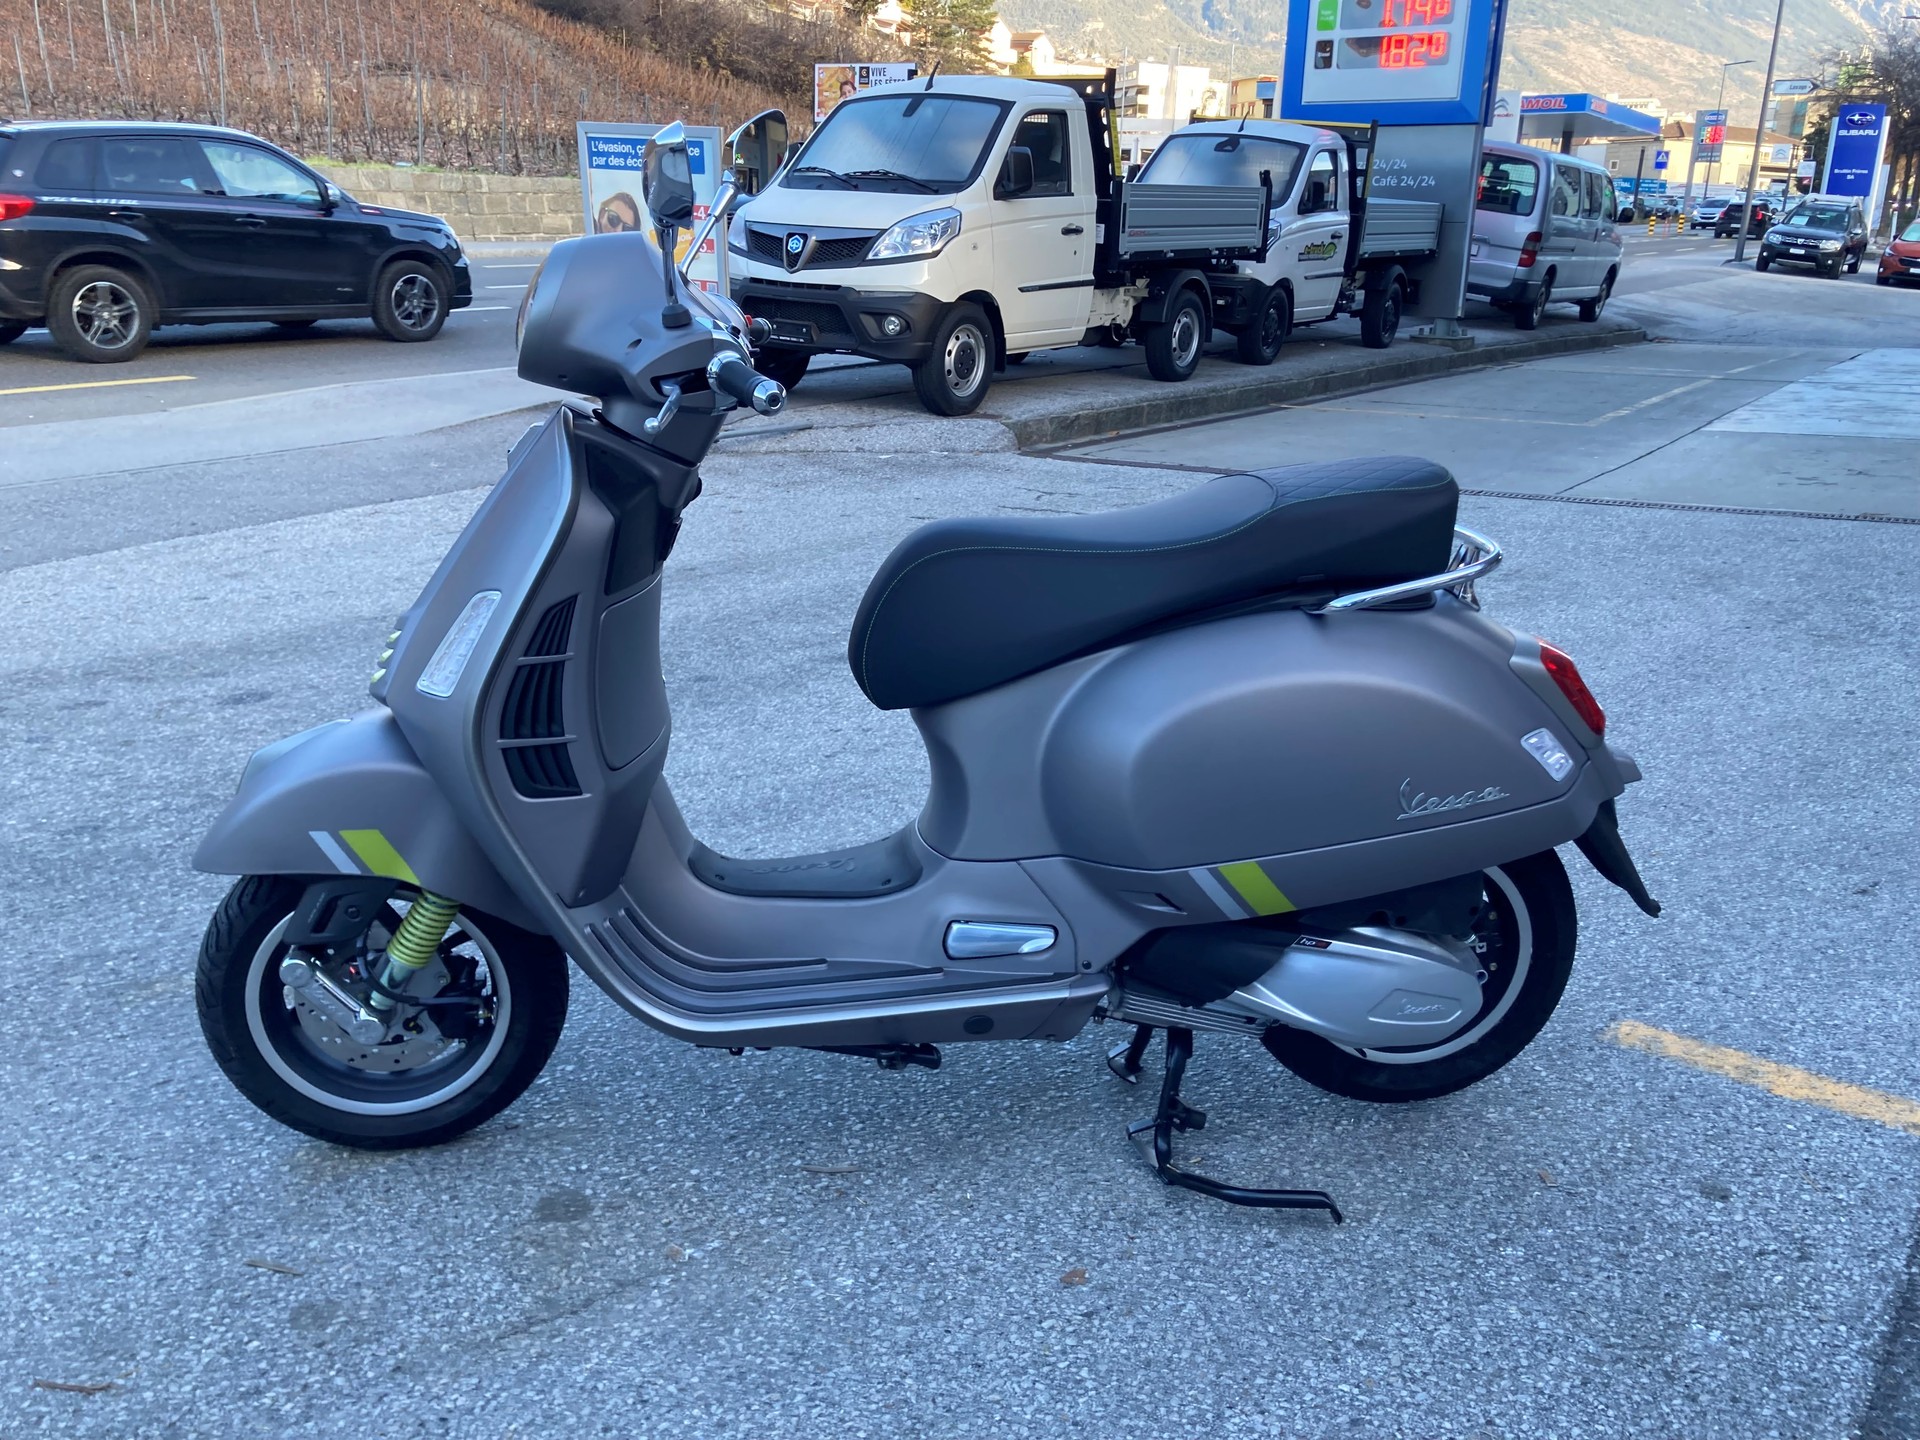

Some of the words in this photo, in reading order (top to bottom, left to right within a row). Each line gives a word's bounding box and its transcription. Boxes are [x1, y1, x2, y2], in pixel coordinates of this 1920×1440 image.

[870, 67, 887, 77] VIVE
[1520, 97, 1568, 110] AMOIL
[591, 140, 635, 156] L'évasion,
[592, 156, 607, 167] par
[608, 155, 625, 167] des
[626, 155, 643, 167] éco
[1373, 159, 1408, 172] 24/24
[1372, 175, 1398, 187] Café
[1400, 175, 1436, 189] 24/24
[1396, 777, 1510, 820] Vespa
